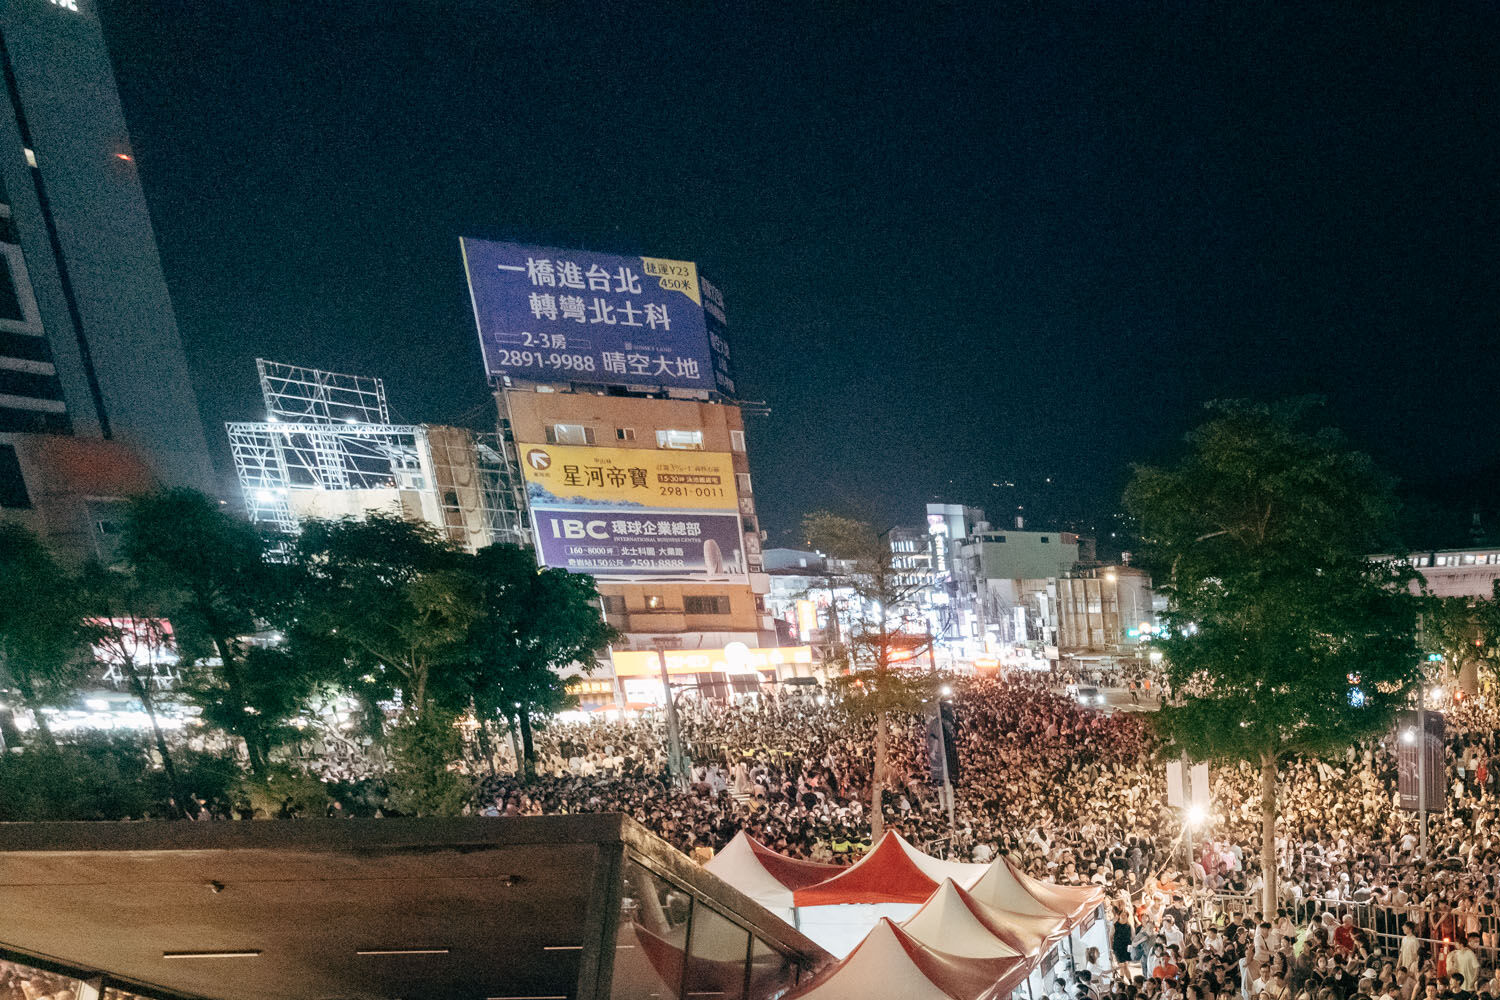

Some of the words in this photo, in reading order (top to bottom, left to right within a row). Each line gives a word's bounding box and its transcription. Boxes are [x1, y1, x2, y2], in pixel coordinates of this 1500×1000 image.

[497, 257, 642, 294] 一橋進台北
[646, 262, 689, 277] 捷運Y23
[661, 279, 692, 290] 450米
[528, 292, 671, 331] 轉彎北士科
[521, 331, 566, 349] 2-3房
[499, 349, 595, 372] 2891-9988
[602, 351, 701, 379] 晴空大地
[563, 465, 649, 489] 星河帝寶
[660, 486, 724, 497] 2981-0011
[550, 518, 610, 539] IBC
[611, 520, 701, 537] 環球企業總部
